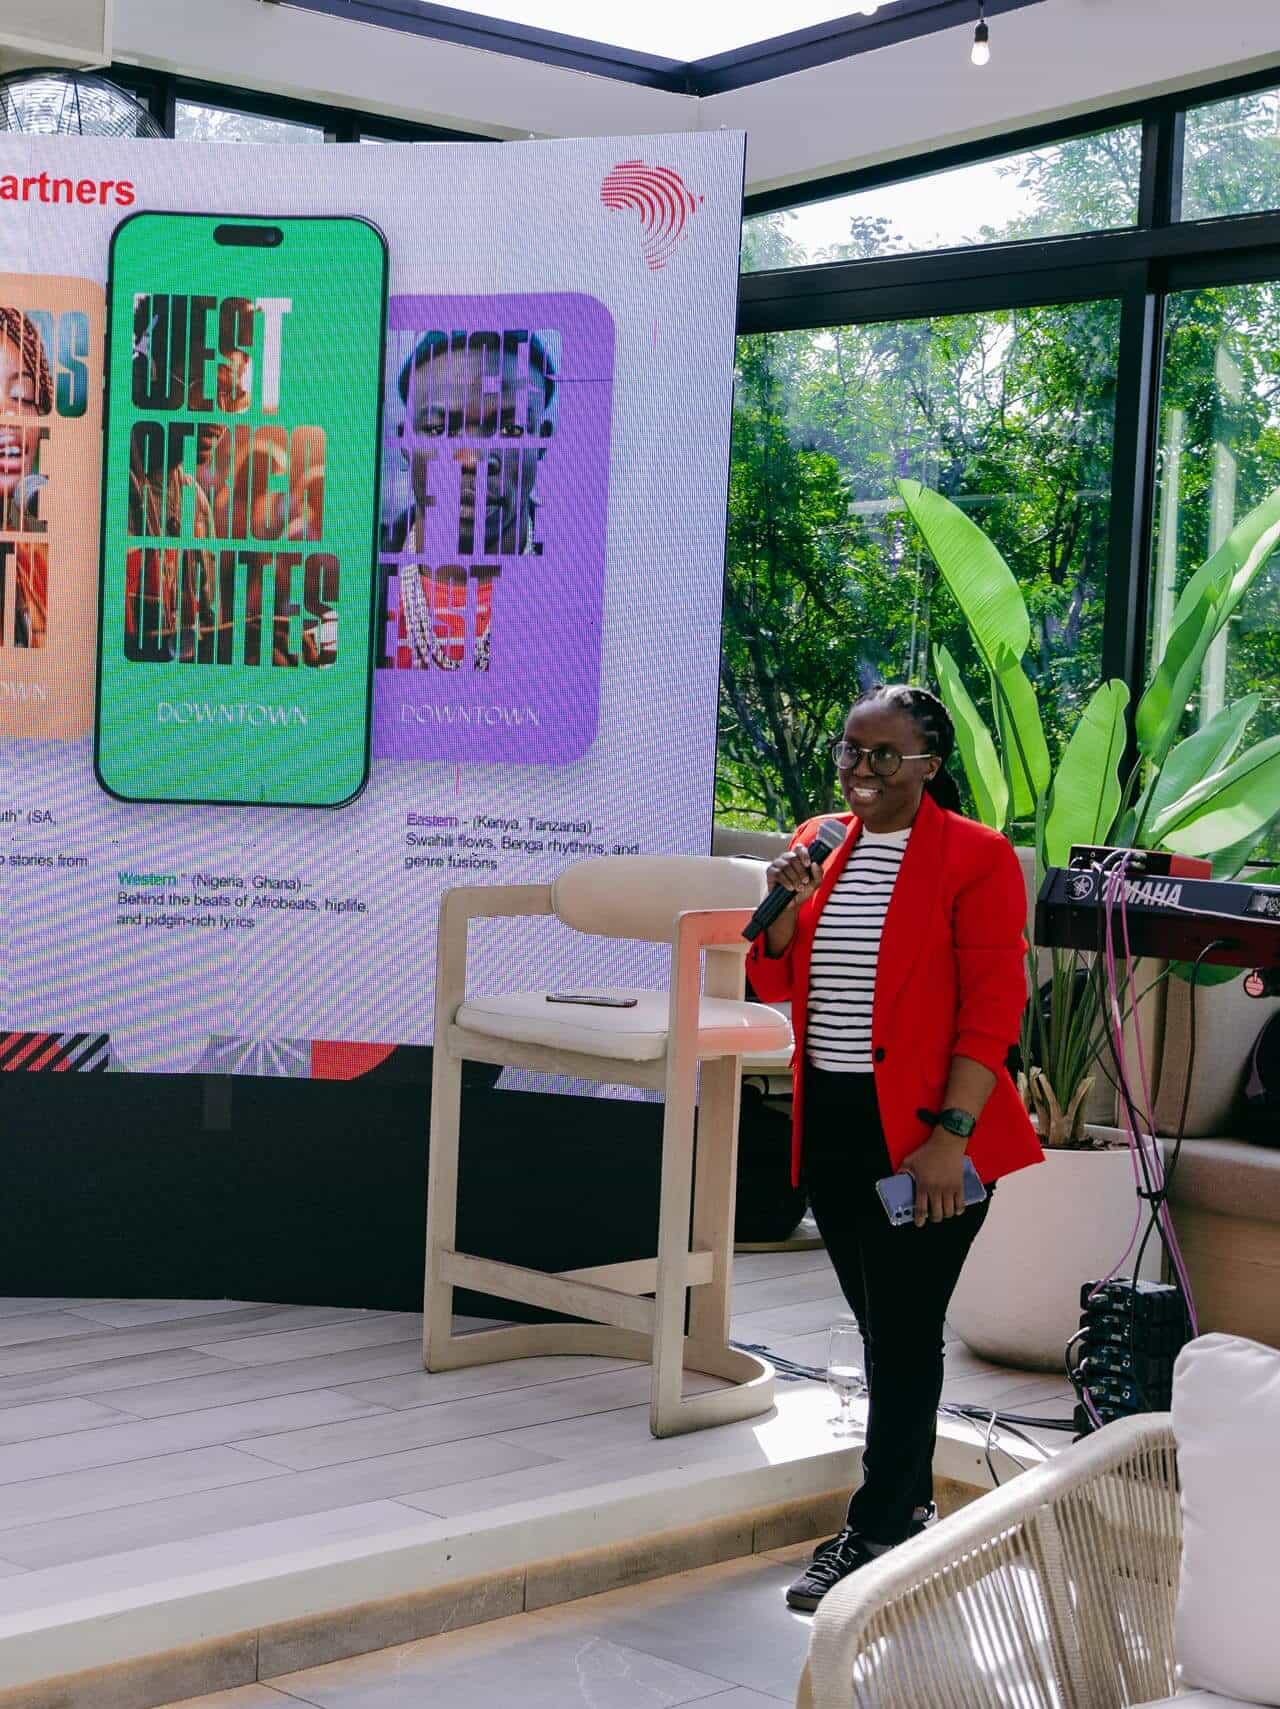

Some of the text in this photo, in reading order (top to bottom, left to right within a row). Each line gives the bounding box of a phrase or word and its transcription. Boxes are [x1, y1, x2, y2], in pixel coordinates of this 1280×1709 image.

[134, 293, 292, 415] WEST
[129, 422, 327, 541] AFRICA
[124, 547, 340, 670] WRITES
[157, 702, 309, 727] DOWNTOWN
[400, 703, 541, 727] DOWNTOWN
[28, 810, 56, 825] (SA,
[407, 814, 457, 826] Eastern
[528, 817, 592, 834] Tanzania)
[406, 833, 453, 847] Swahili
[458, 835, 496, 849] flows,
[502, 837, 543, 853] Benga
[613, 843, 639, 855] and
[9, 855, 53, 867] stories
[58, 855, 87, 867] from
[405, 855, 497, 869] genre fusions
[119, 873, 176, 886] Western
[252, 876, 301, 892] Ghana)
[119, 892, 165, 906] Behind
[169, 894, 189, 906] the
[194, 894, 231, 907] beats
[235, 895, 249, 907] of
[117, 913, 255, 930] and pidgin-rich lyrics
